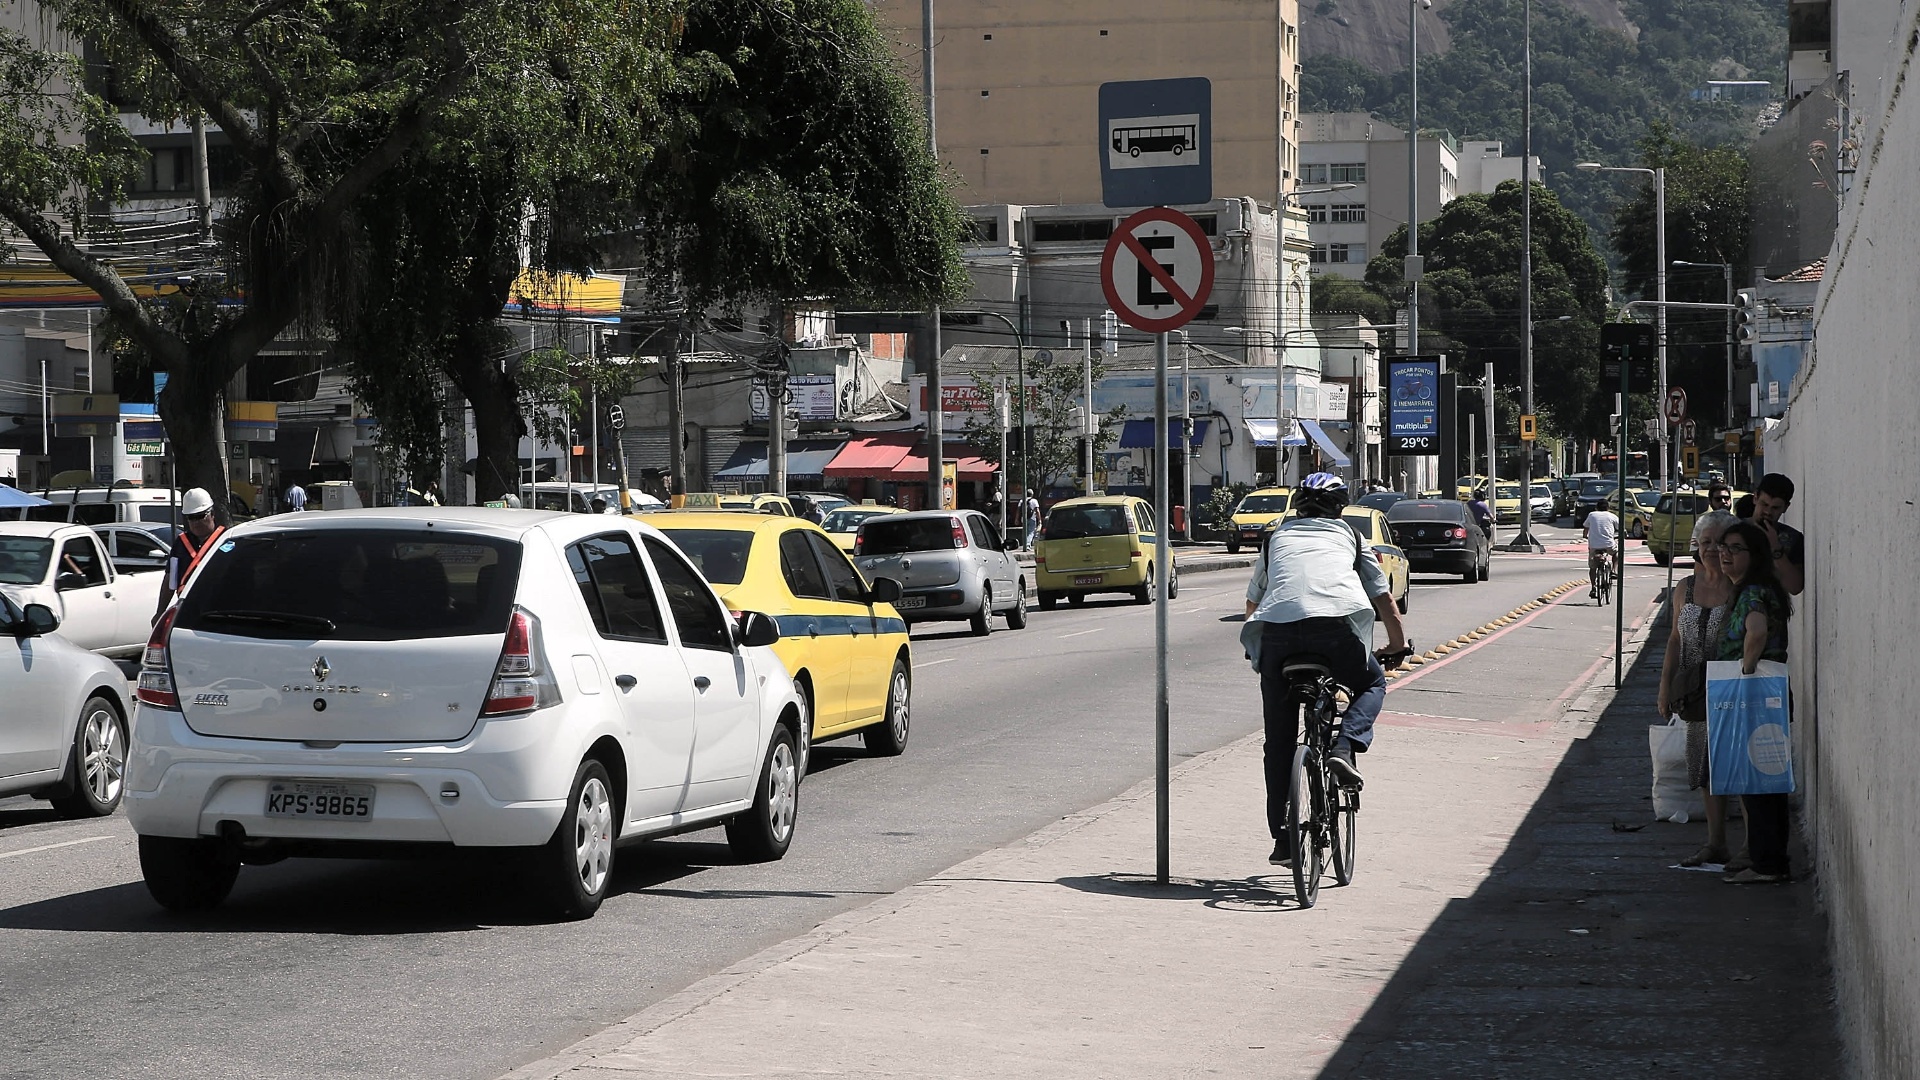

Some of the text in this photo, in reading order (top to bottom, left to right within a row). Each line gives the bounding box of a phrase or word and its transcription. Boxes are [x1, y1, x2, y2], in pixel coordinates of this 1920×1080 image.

[1394, 367, 1434, 376] TROCAR PONTOS
[1395, 423, 1428, 431] multiplus
[140, 443, 161, 453] Natural
[687, 494, 716, 506] TAXI
[282, 684, 361, 694] SANDERO
[195, 693, 229, 701] EIFFEL
